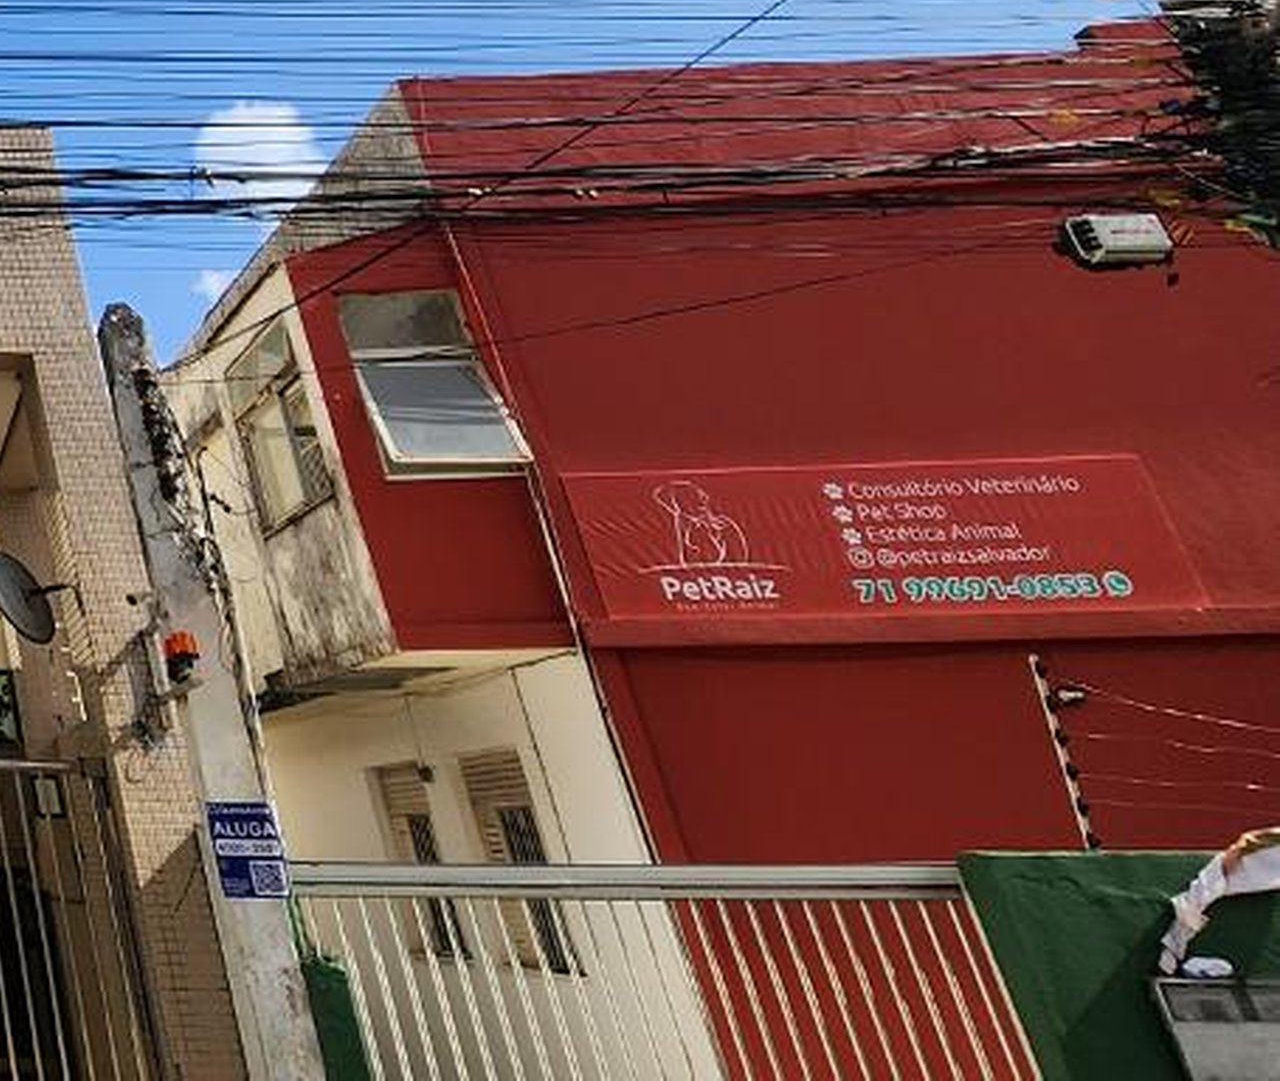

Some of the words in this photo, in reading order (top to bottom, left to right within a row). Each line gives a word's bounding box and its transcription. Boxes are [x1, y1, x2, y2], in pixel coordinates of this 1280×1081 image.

[848, 478, 963, 500] Consultório
[966, 475, 1081, 496] Veterinário
[856, 503, 892, 520] Pet
[894, 502, 948, 521] Shop
[865, 523, 947, 542] Estética
[951, 522, 1023, 541] Animal
[660, 573, 781, 601] PetRaiz
[852, 577, 899, 604] 71
[213, 821, 276, 837] ALUGA
